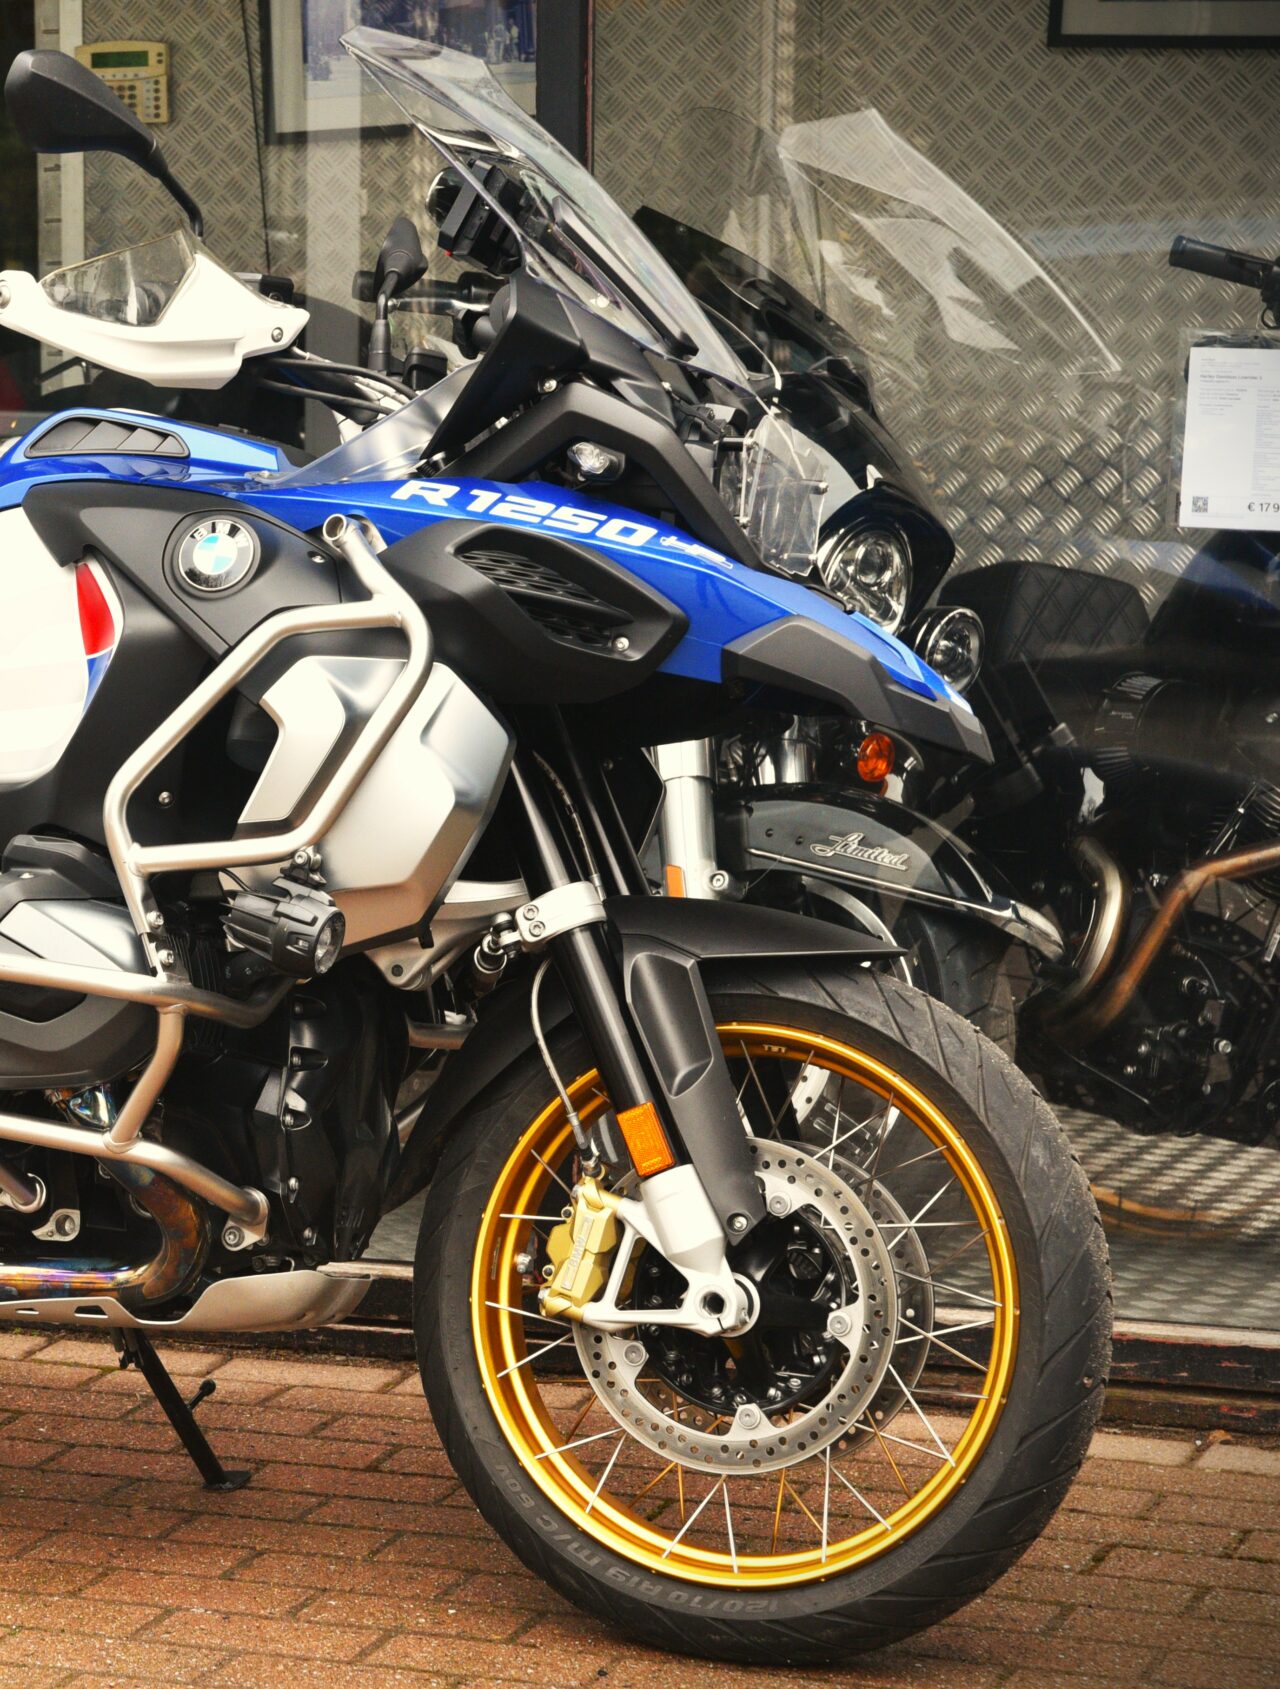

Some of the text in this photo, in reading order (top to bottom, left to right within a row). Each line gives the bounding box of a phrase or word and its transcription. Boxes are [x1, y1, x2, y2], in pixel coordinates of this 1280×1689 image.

[390, 479, 461, 507] R
[465, 489, 658, 547] 1250
[193, 522, 249, 548] BMW
[810, 832, 909, 871] Limited
[604, 1566, 662, 1597] R19
